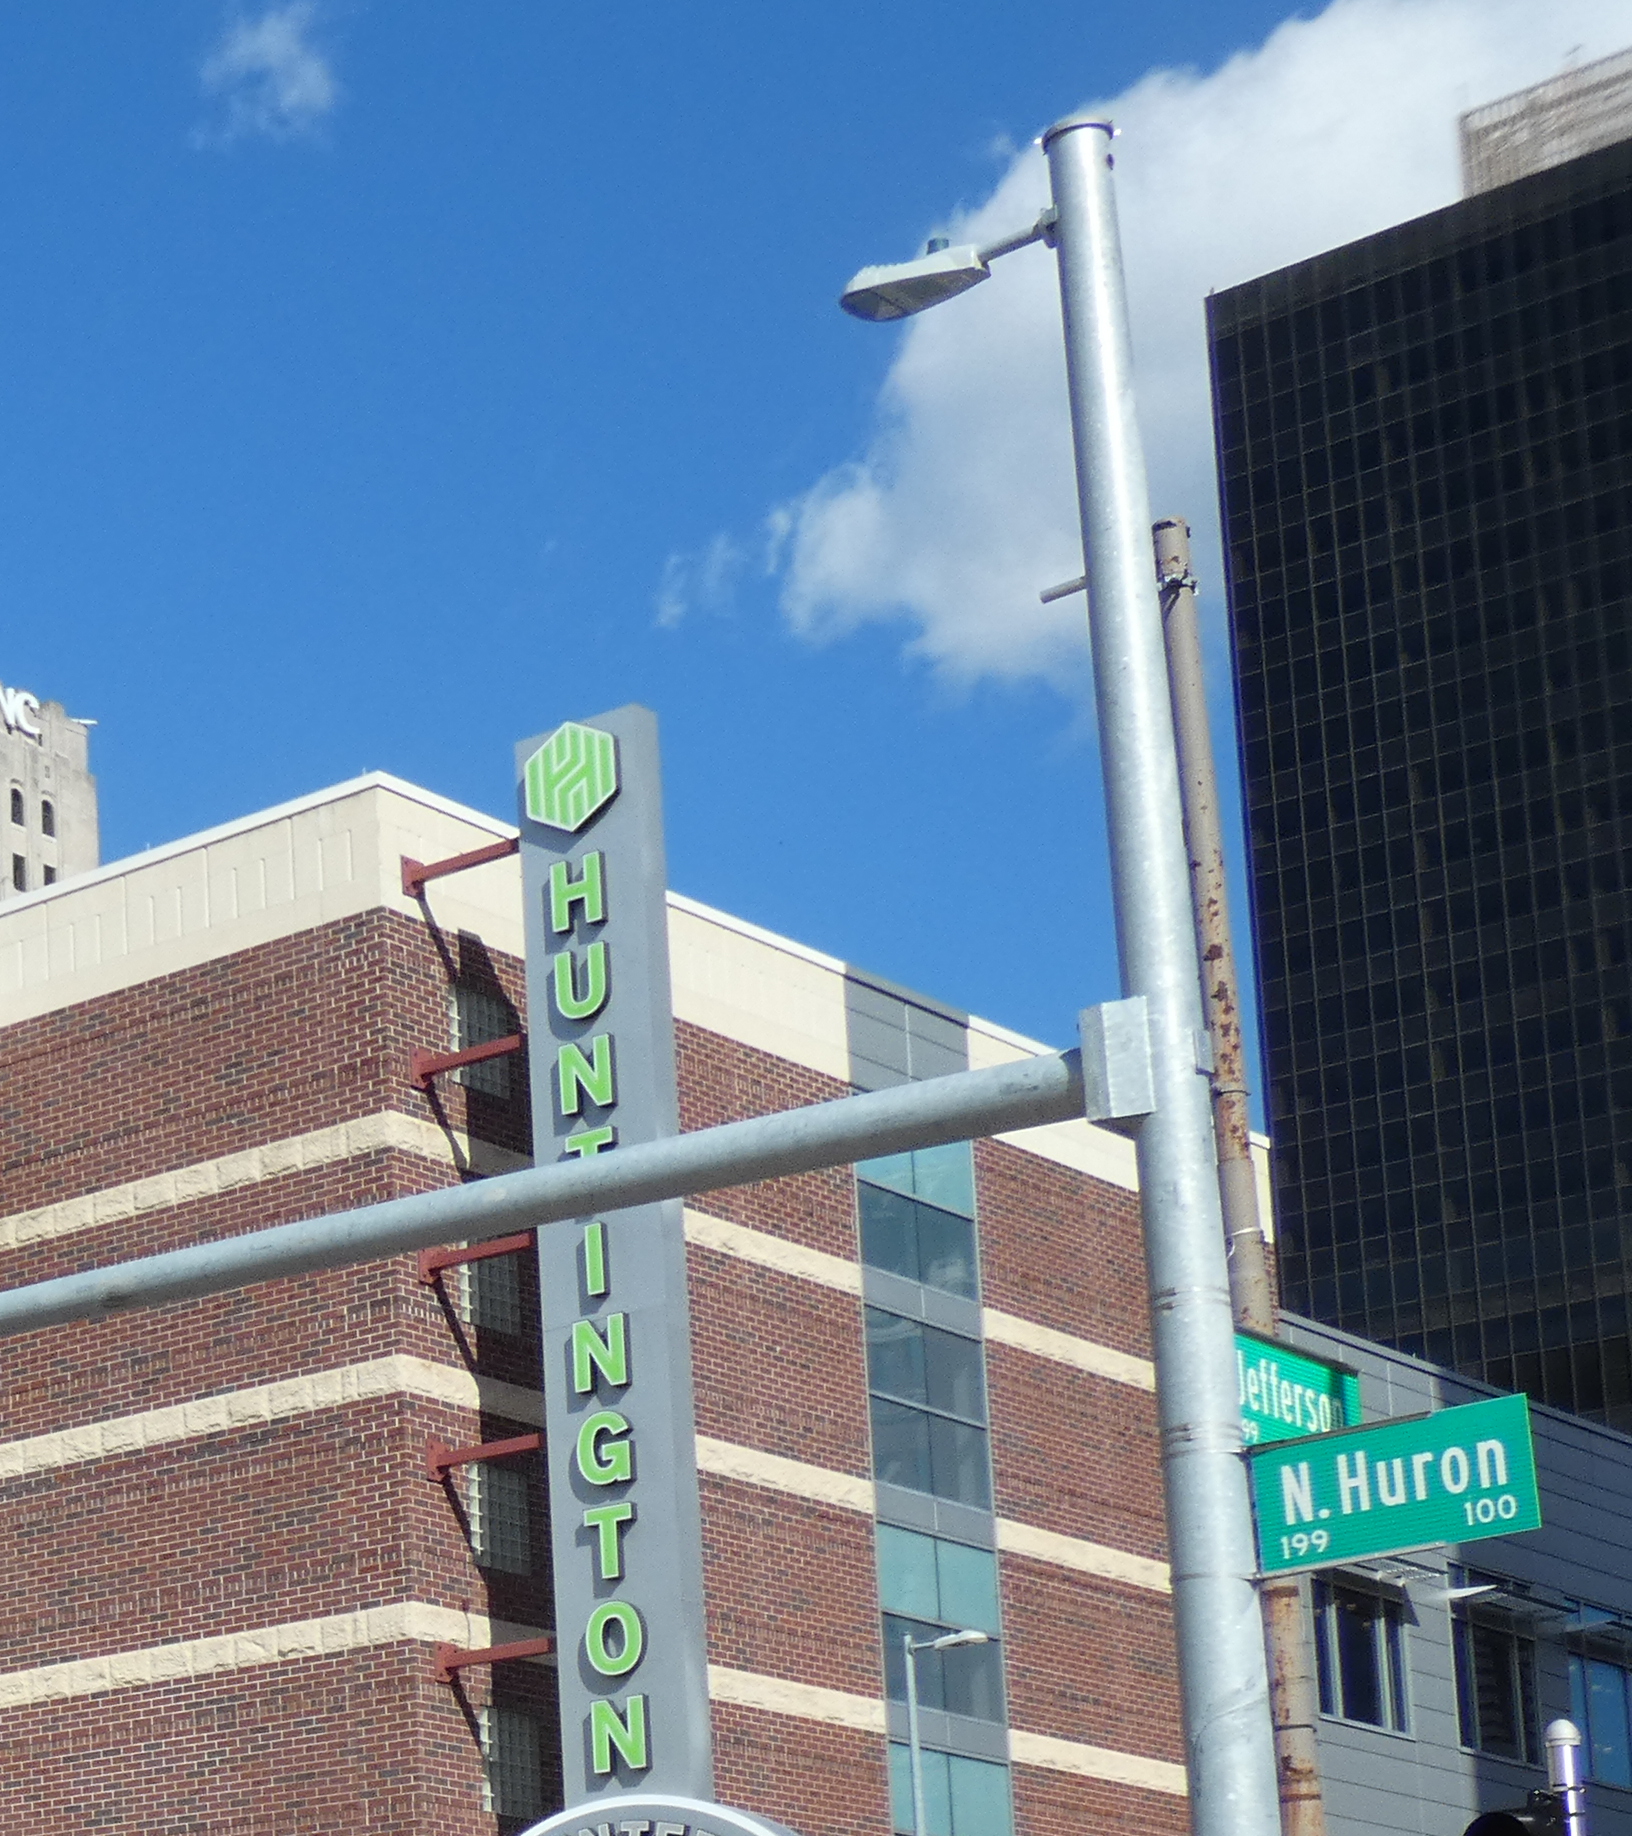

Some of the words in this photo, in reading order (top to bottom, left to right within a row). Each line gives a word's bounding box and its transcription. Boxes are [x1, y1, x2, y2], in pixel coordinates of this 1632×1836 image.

[549, 850, 646, 1774] HUNTINGTON
[1280, 1462, 1331, 1526] N.
[1337, 1439, 1508, 1515] Huron
[1280, 1530, 1329, 1559] 199
[1464, 1495, 1517, 1526] 100
